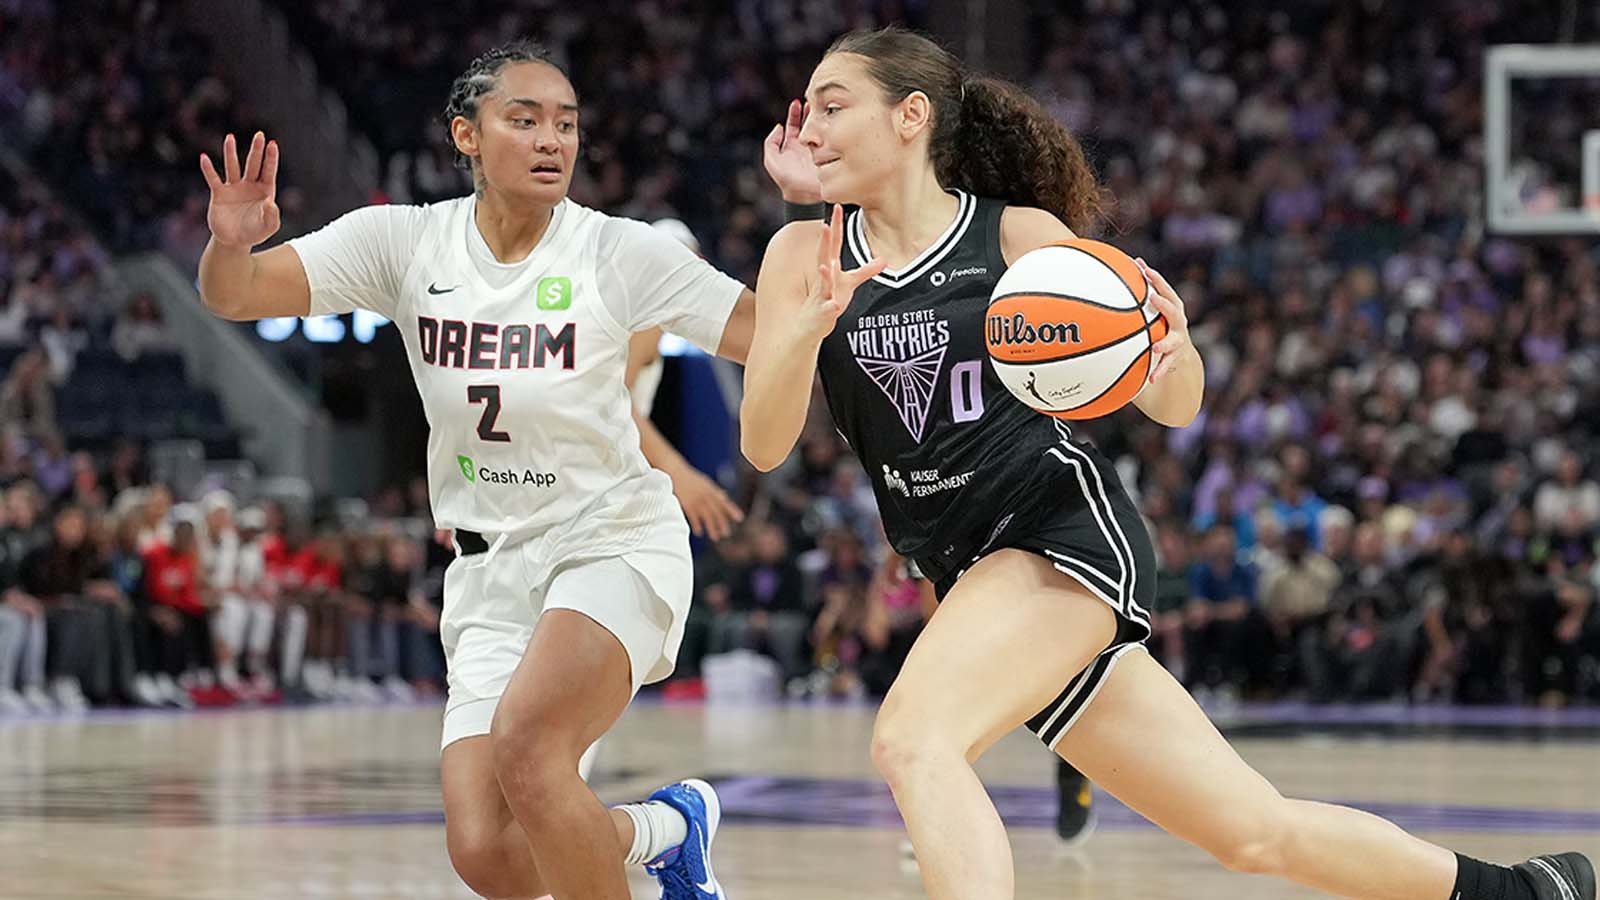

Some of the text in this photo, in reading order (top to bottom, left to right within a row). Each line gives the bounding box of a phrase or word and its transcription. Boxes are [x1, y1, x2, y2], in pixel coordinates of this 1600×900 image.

[949, 266, 987, 282] freedom
[858, 309, 935, 329] GOLDEN STATE
[988, 313, 1082, 346] Wilson
[418, 316, 576, 370] DREAM
[847, 320, 950, 361] VALKYRIES
[951, 360, 985, 423] 0
[467, 385, 511, 442] 2
[479, 467, 556, 487] Cash App
[910, 469, 939, 482] KAISER
